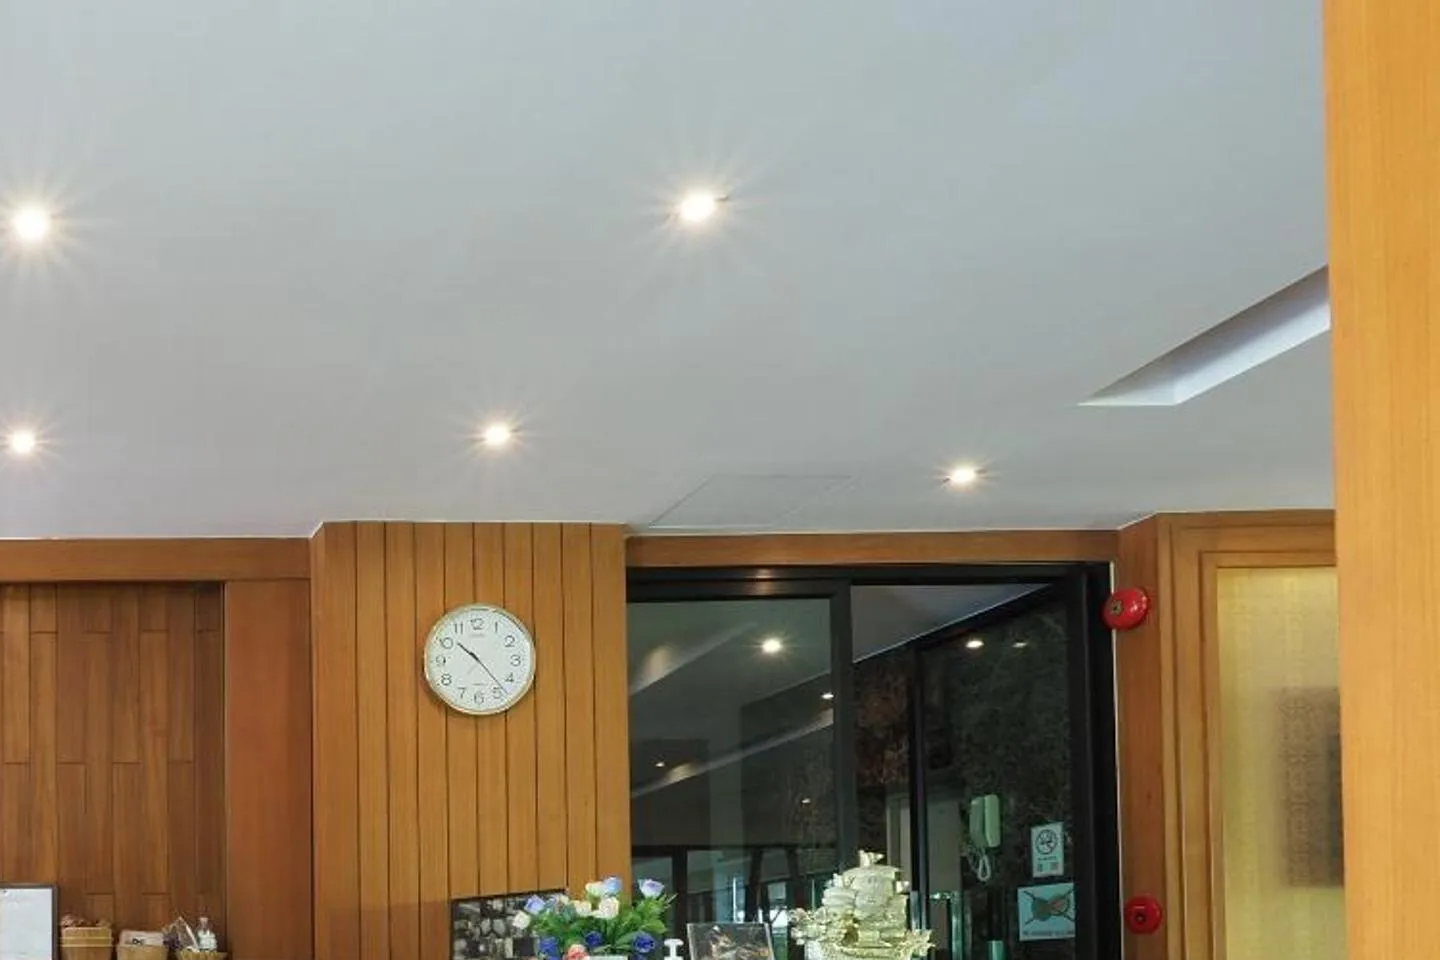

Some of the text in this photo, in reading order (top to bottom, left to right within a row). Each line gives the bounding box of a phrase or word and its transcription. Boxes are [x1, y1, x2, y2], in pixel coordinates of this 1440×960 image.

[470, 618, 484, 630] 12
[504, 635, 515, 647] 2
[510, 654, 521, 667] 3
[441, 673, 452, 686] 8
[505, 672, 515, 682] 4
[458, 687, 466, 699] 7
[474, 690, 484, 704] 6
[492, 687, 502, 699] 5
